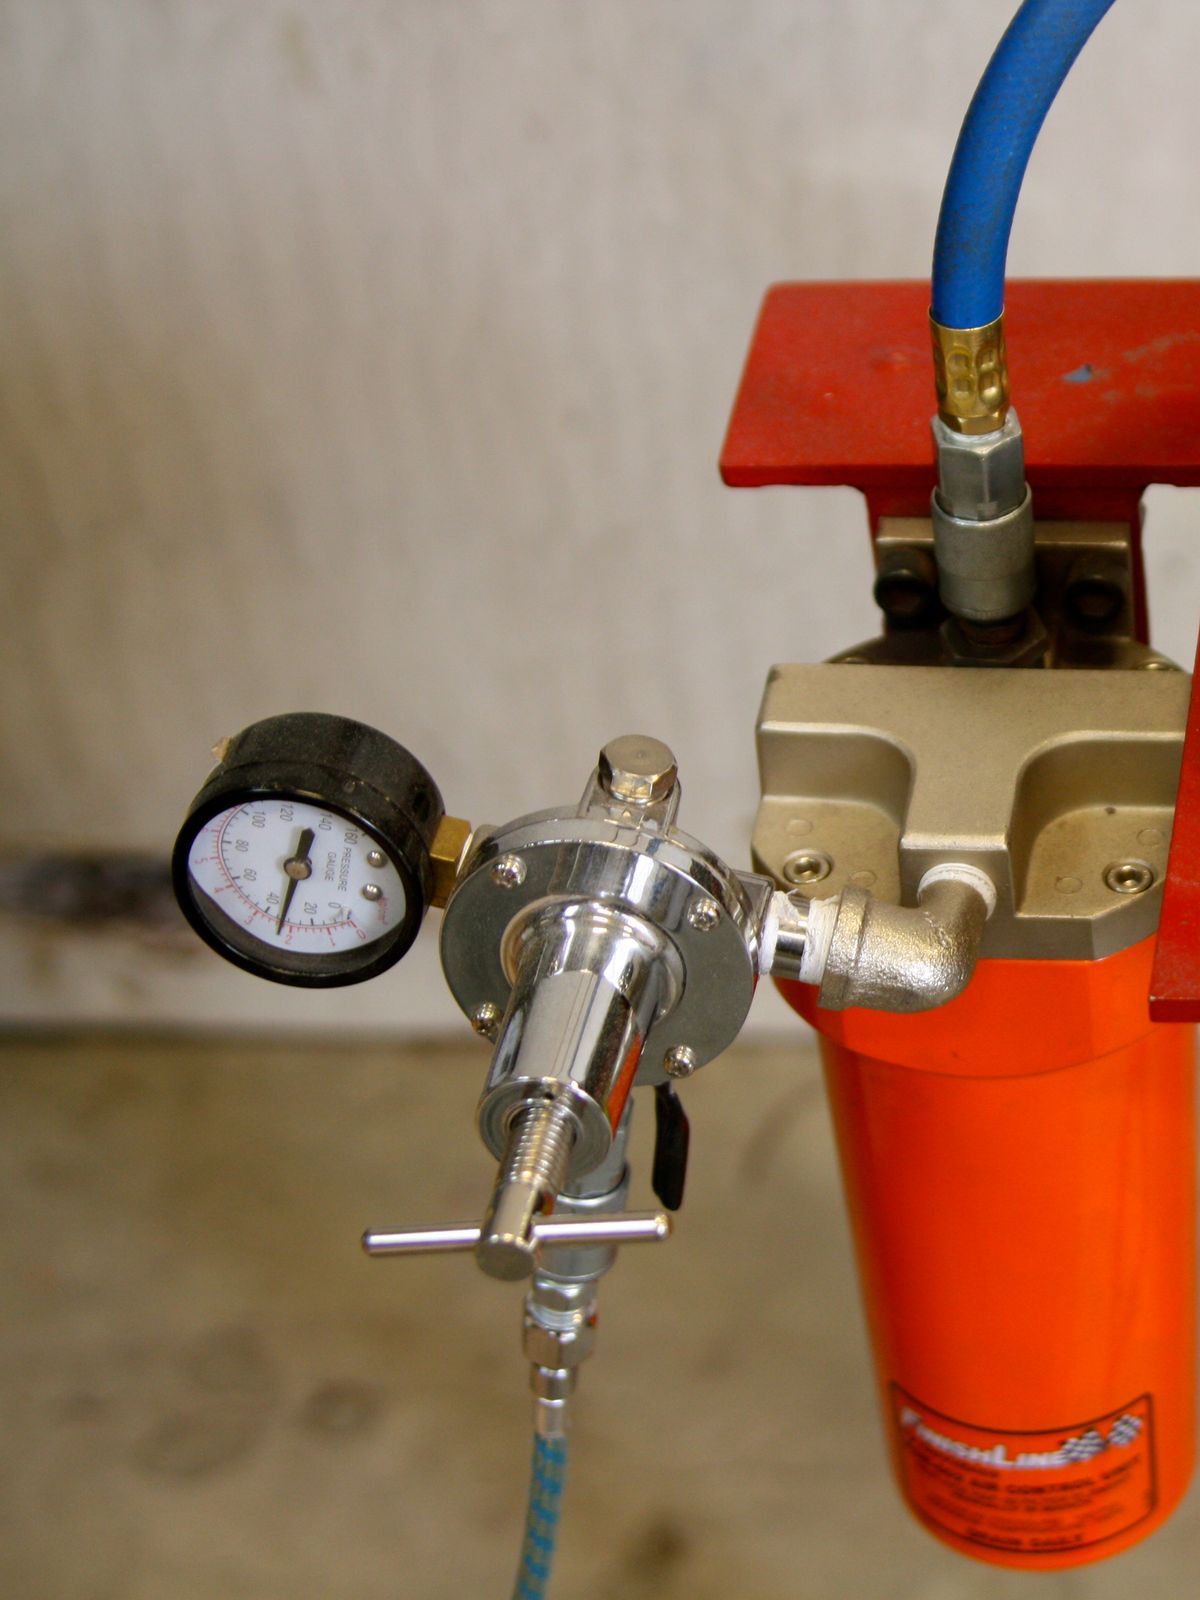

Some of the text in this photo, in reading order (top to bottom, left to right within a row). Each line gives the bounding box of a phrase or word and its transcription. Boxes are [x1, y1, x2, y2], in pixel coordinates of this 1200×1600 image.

[251, 811, 266, 828] 100
[280, 804, 294, 822] 120
[318, 813, 333, 831] 140
[344, 827, 358, 845] 160
[235, 839, 249, 852] 80
[324, 851, 336, 880] GAUGE
[337, 847, 351, 891] PRESSURE
[243, 868, 257, 881] 60
[266, 891, 280, 905] 40
[304, 901, 318, 915] 20
